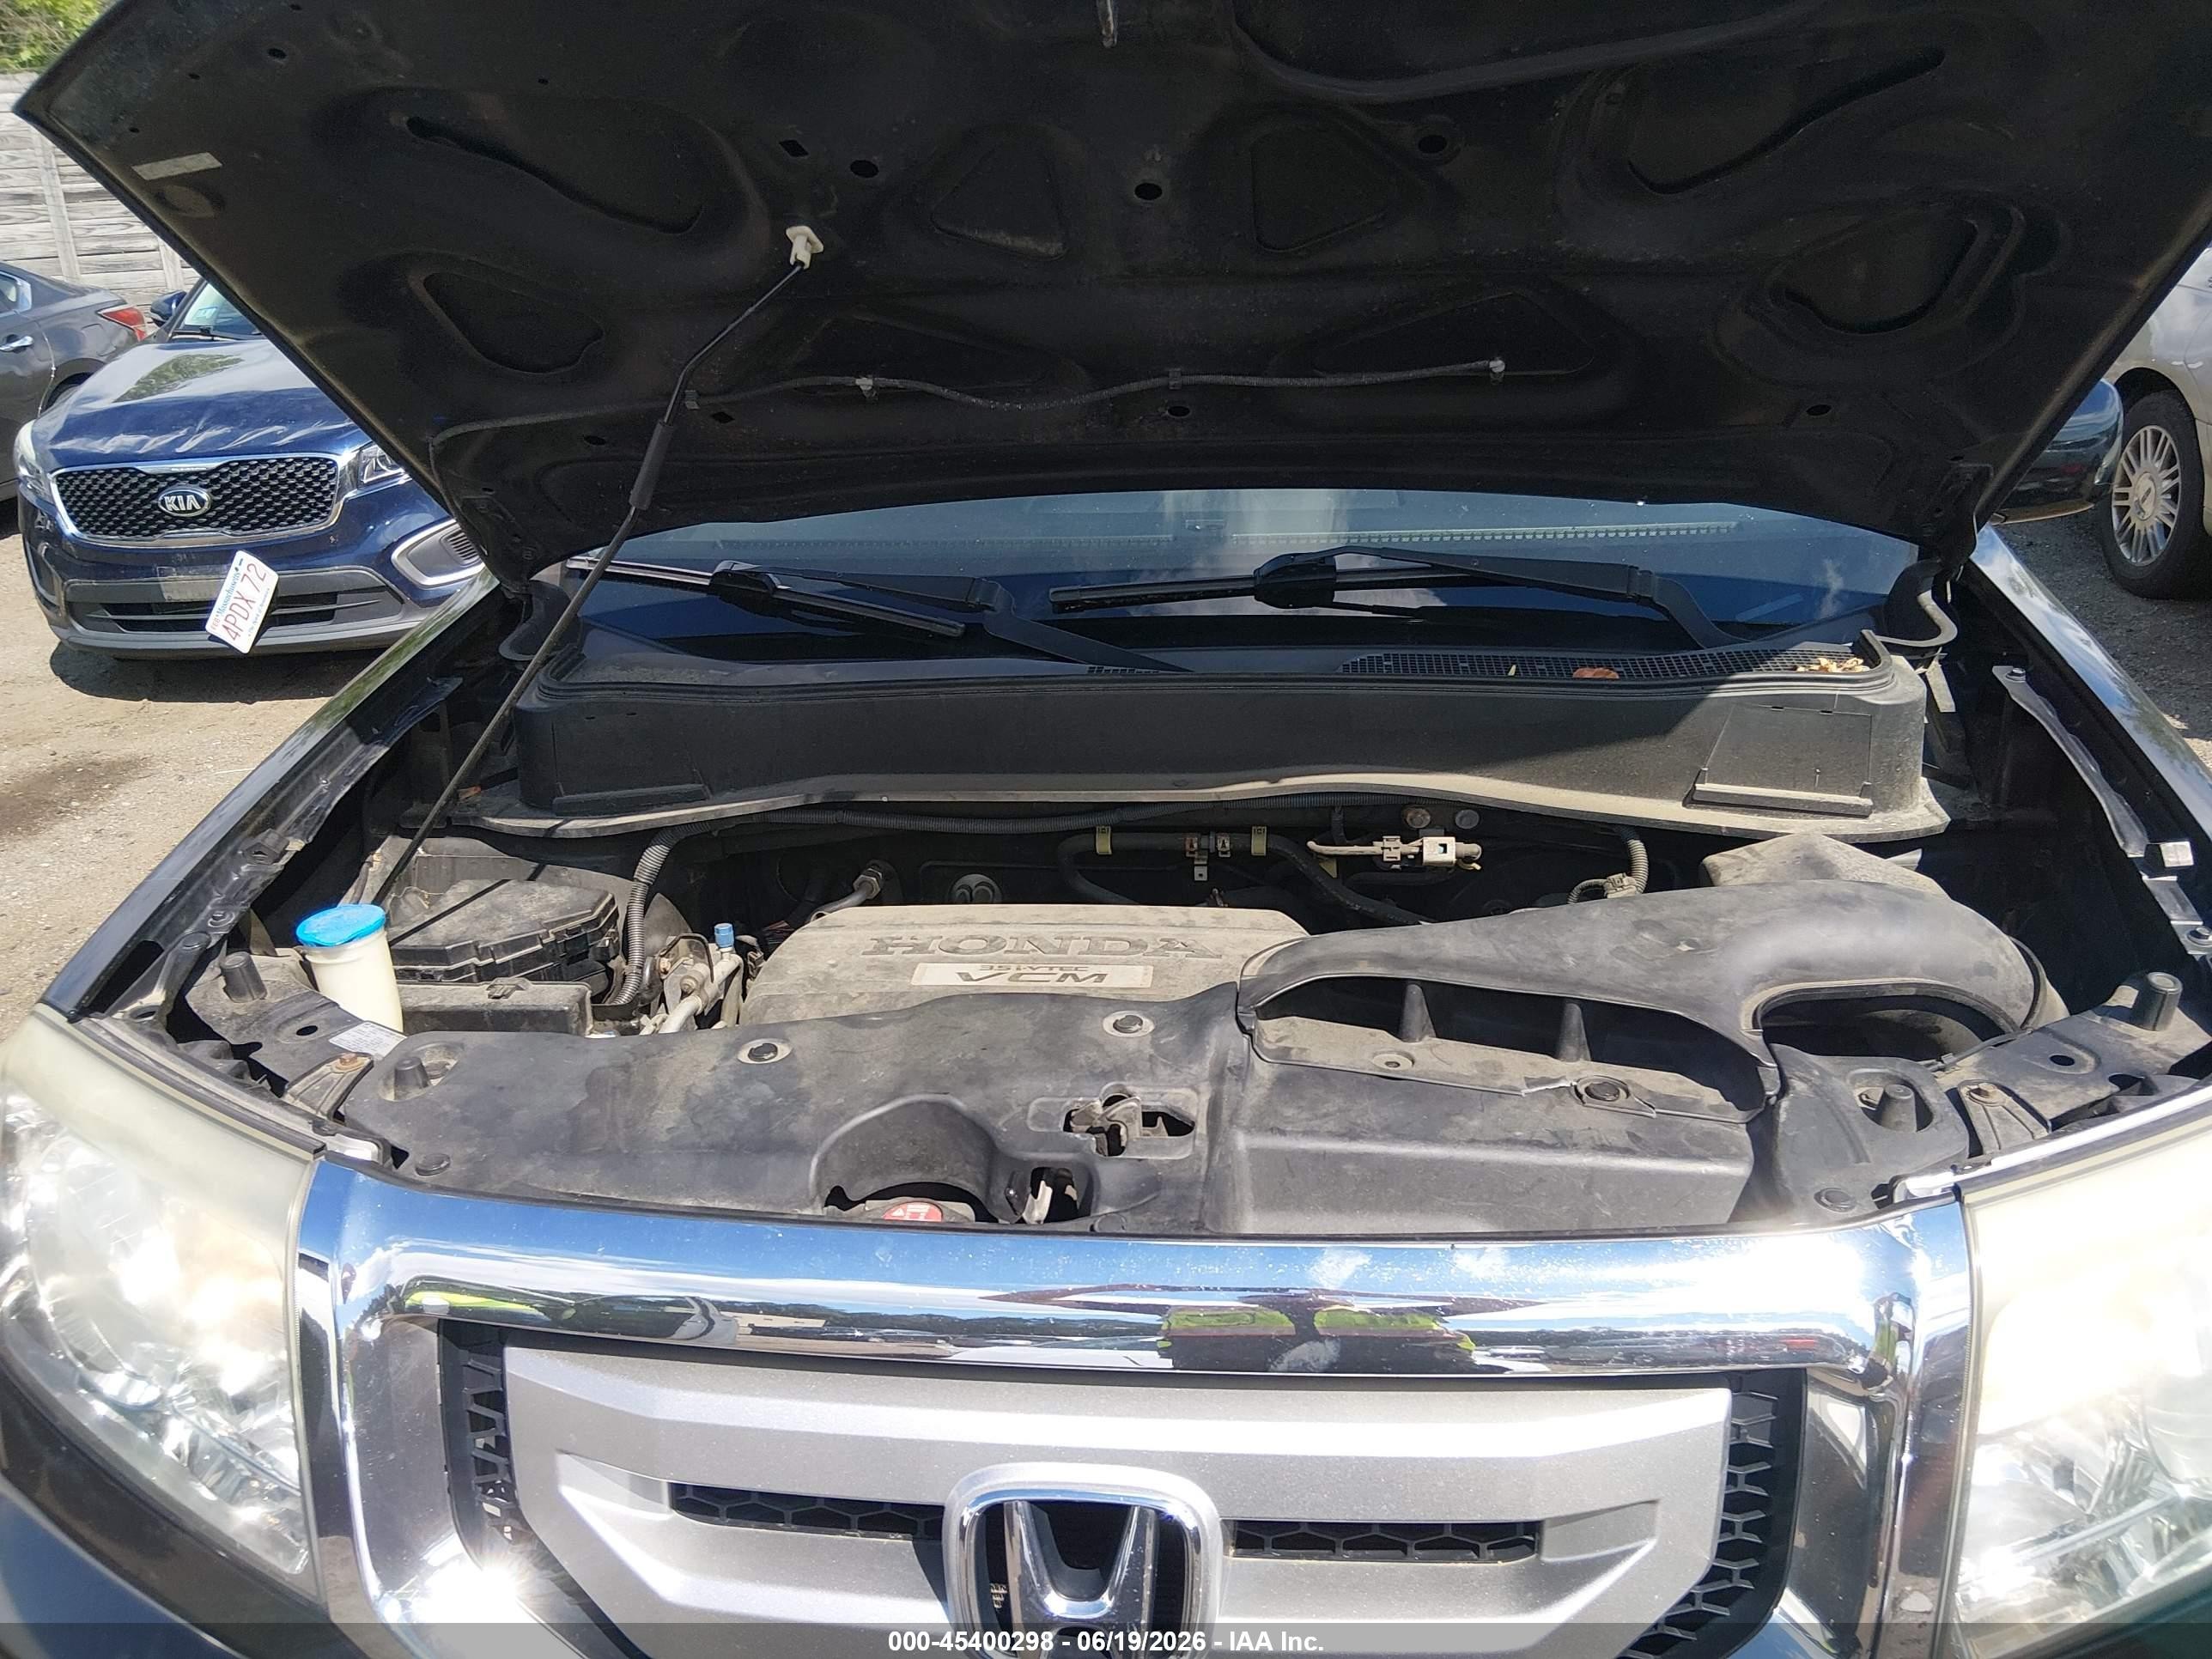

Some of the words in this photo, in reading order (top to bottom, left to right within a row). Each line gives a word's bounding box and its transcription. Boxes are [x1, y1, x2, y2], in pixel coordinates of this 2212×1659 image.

[164, 495, 201, 511] KIA
[222, 591, 257, 641] 4PDX
[240, 562, 267, 592] 72
[861, 934, 1223, 958] HONDA
[955, 971, 1109, 983] VCM
